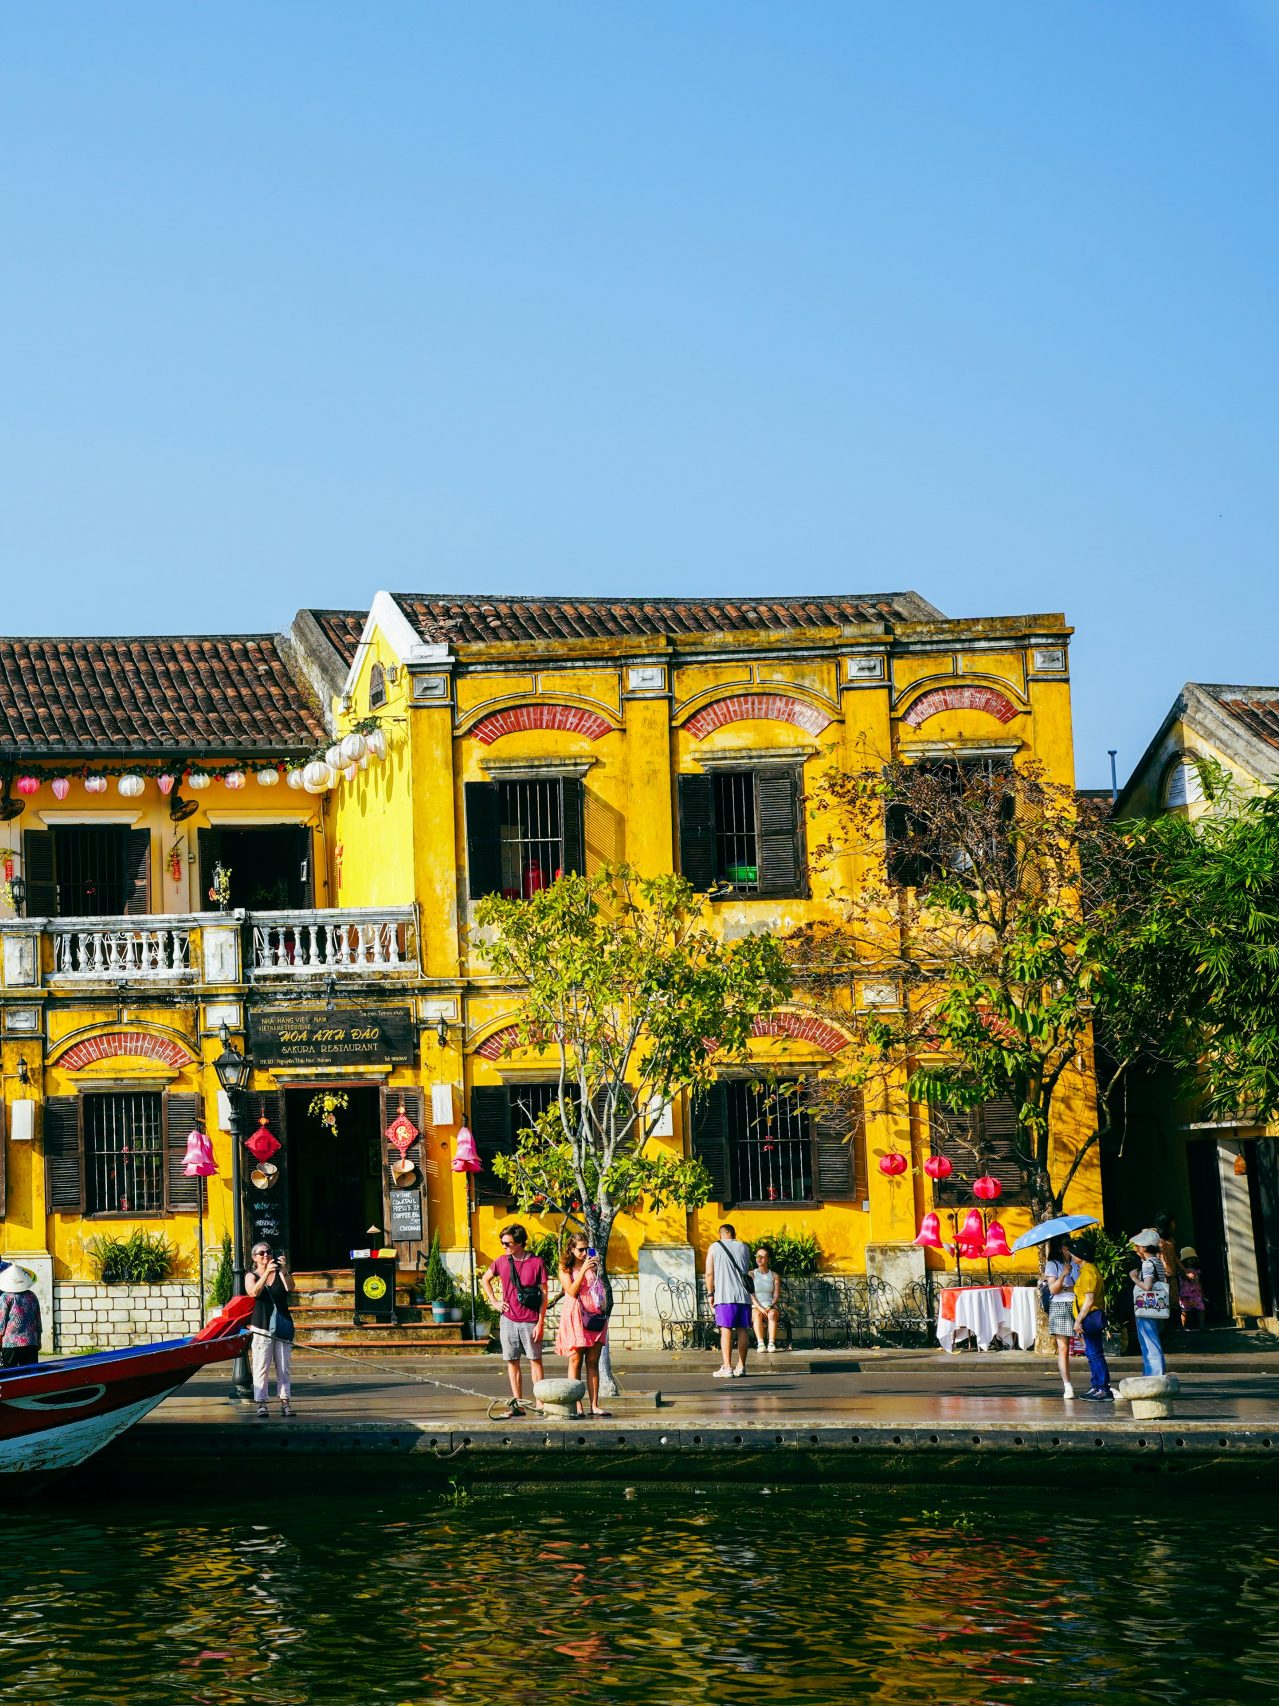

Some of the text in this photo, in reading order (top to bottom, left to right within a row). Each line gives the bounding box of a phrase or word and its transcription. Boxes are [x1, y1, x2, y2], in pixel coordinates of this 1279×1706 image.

[278, 1030, 308, 1042] HOA
[312, 1028, 346, 1042] ANH
[281, 1043, 379, 1054] SAKURA RESTAURANT
